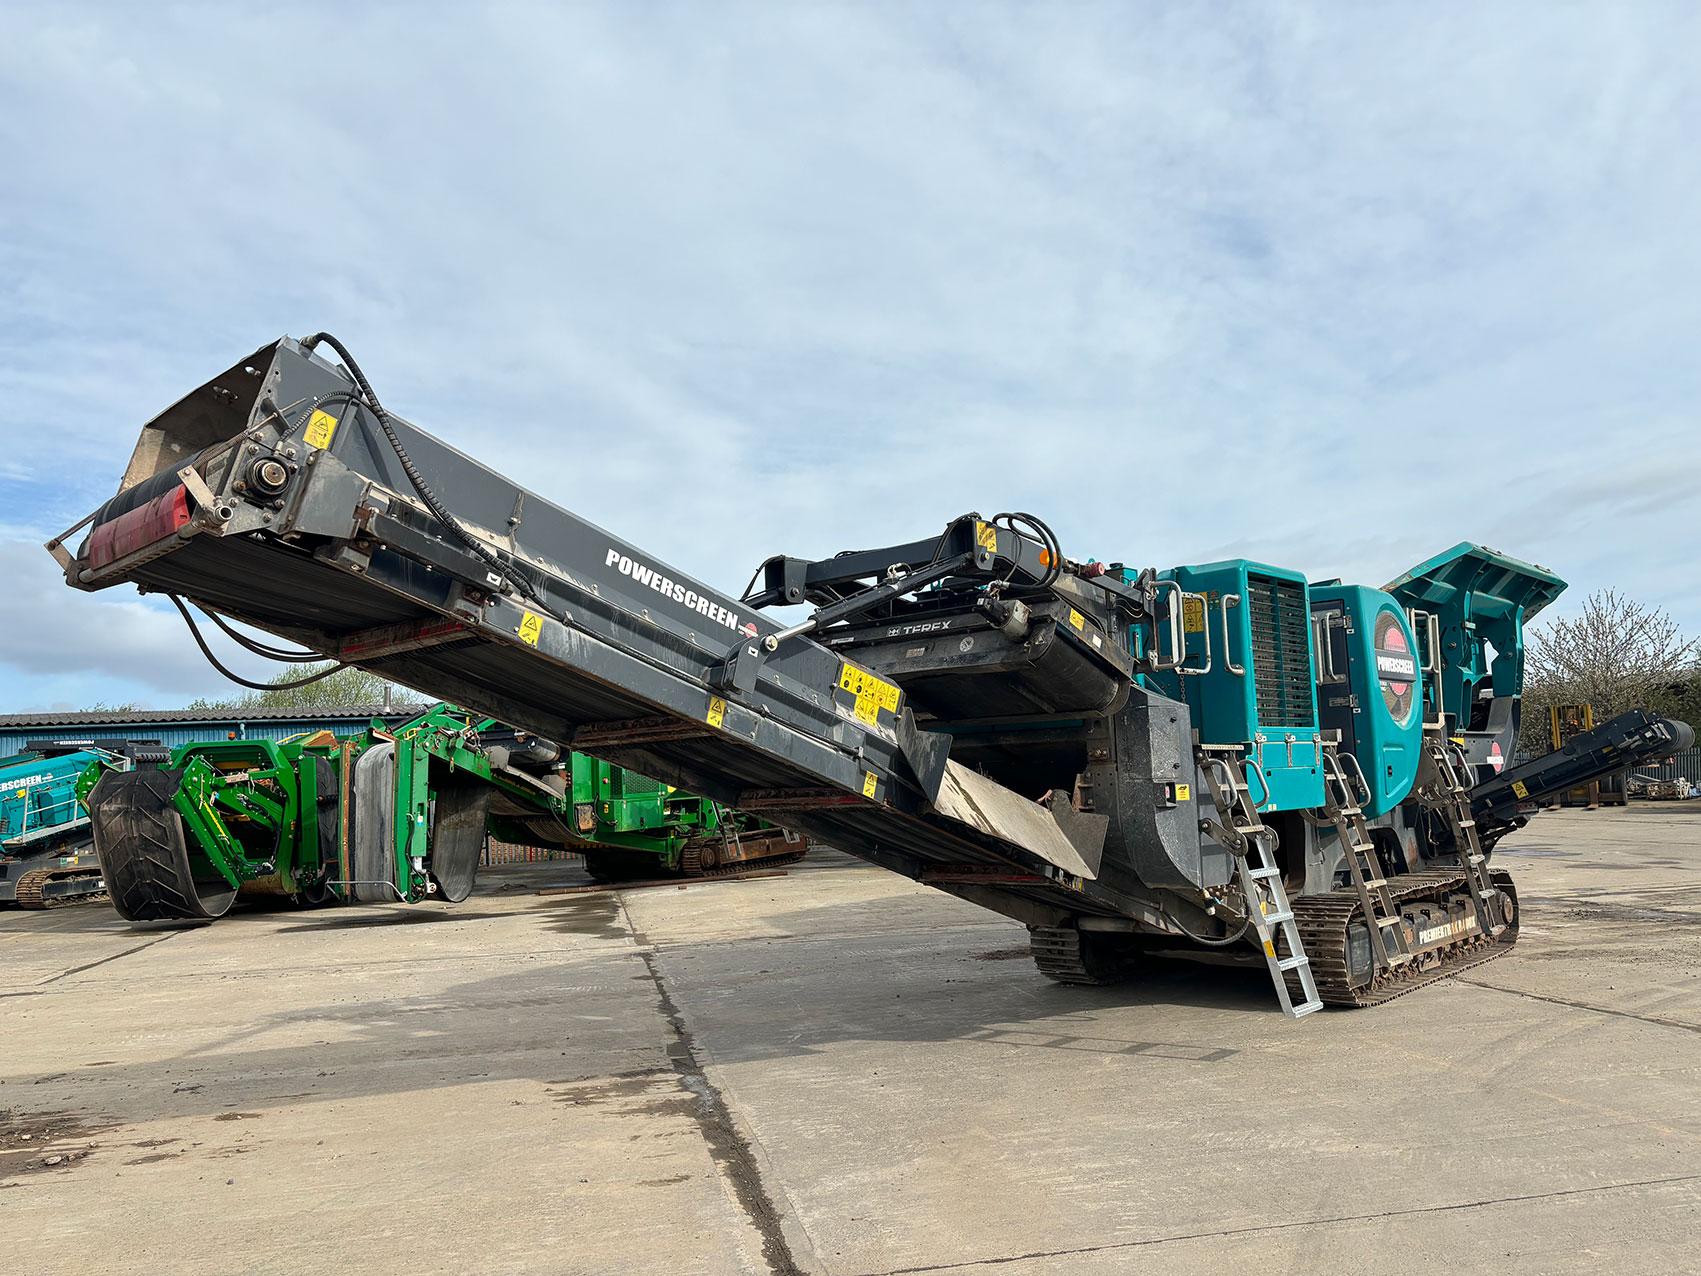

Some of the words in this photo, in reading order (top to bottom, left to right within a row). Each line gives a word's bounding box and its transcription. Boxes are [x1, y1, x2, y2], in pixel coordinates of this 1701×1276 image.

[605, 549, 738, 630] POWERSCREEN
[1377, 656, 1414, 674] POWERSCREEN
[0, 774, 42, 792] RSCREEN
